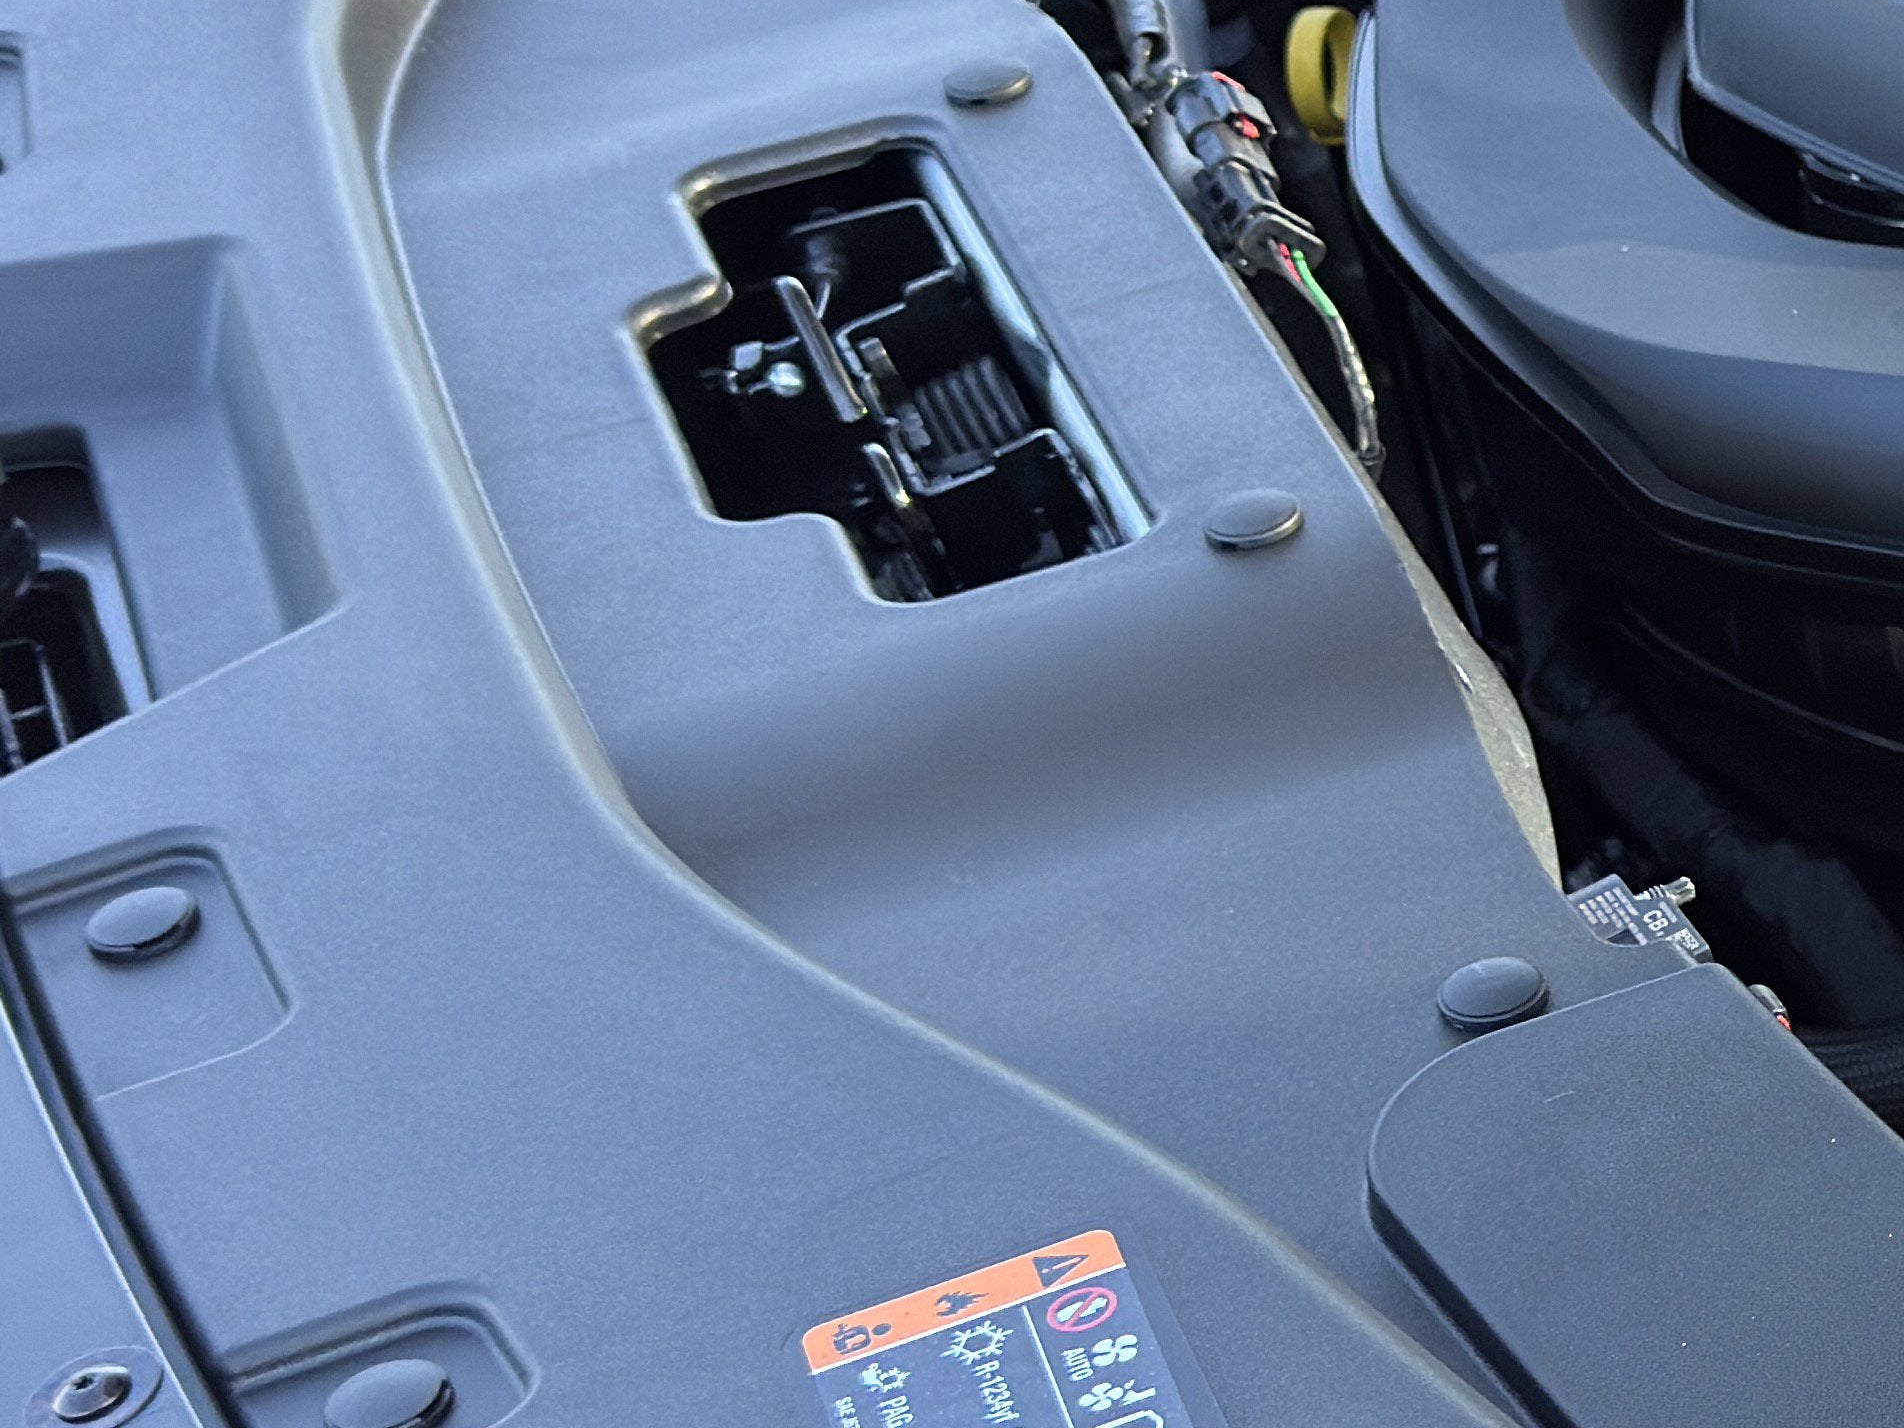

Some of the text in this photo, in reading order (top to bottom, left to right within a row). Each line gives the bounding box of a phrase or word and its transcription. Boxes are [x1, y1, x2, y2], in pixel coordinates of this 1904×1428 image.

[1063, 1348, 1093, 1381] AUTO
[835, 1397, 856, 1417] SAE
[971, 1360, 1020, 1424] R-1234yf
[877, 1396, 913, 1428] PAG
